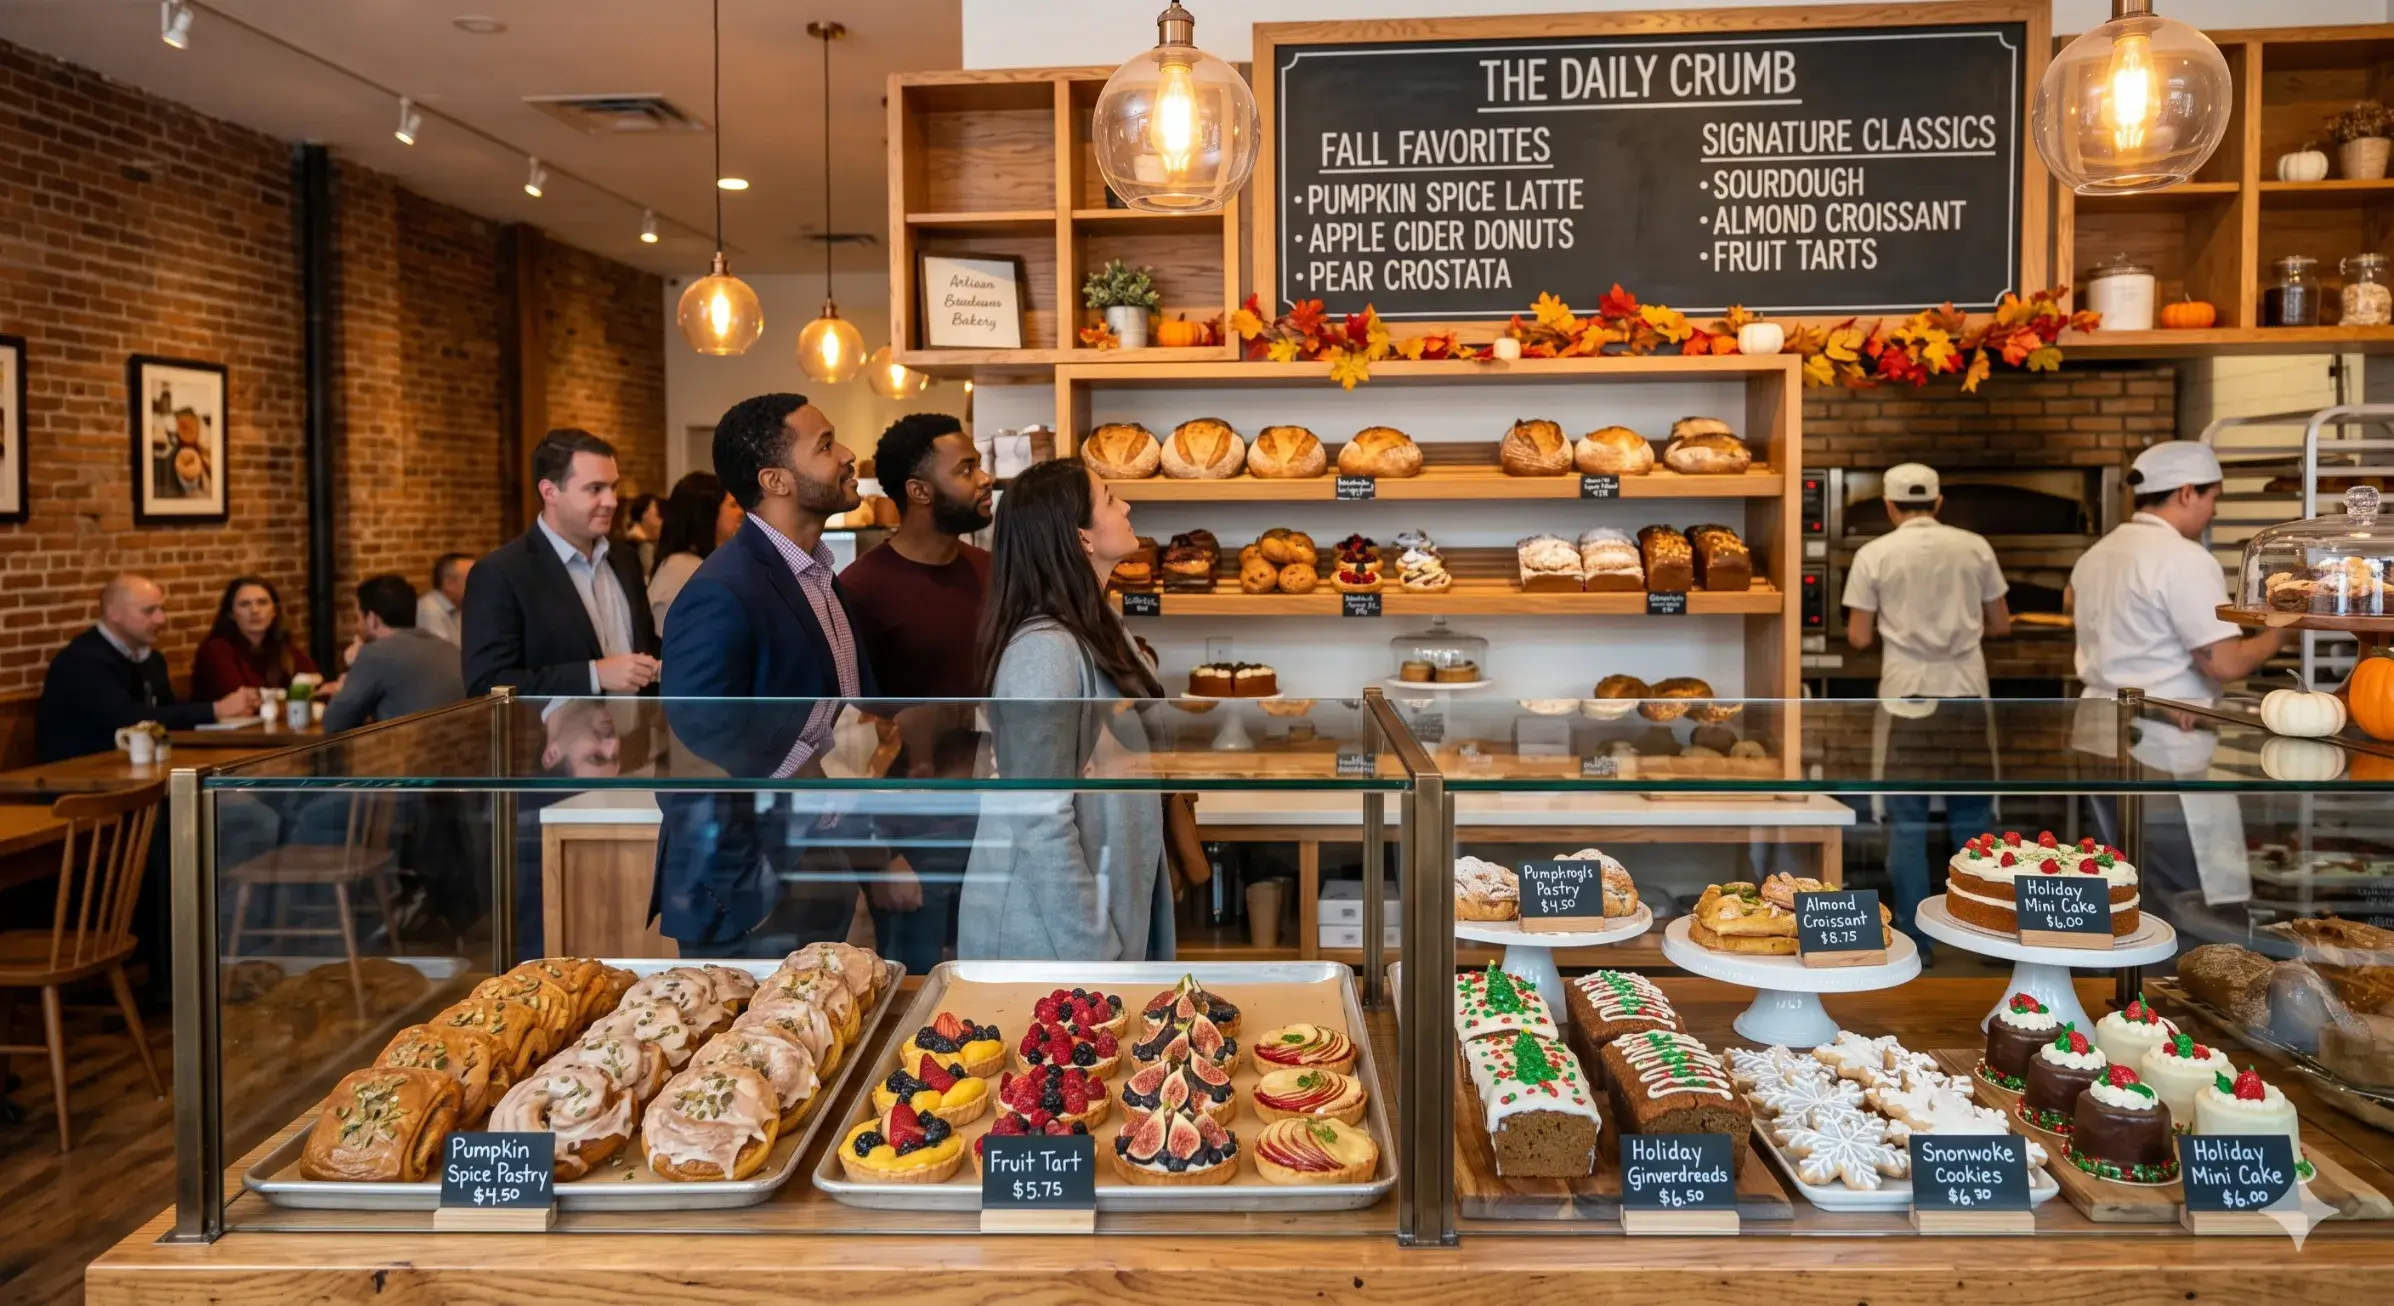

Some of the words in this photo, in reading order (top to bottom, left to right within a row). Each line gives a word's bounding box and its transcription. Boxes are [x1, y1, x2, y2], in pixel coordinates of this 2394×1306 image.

[1479, 58, 1548, 102] THE
[1560, 55, 1659, 100] DAILY
[1669, 50, 1797, 97] CRUMB
[1701, 119, 1854, 155] SIGNATURE
[1862, 115, 1997, 151] CLASSICS
[1321, 131, 1389, 167] FALL
[1398, 126, 1551, 165] FAVORITES
[1712, 166, 1865, 200] SOURDOUGH
[1308, 182, 1417, 215] PUMPKIN
[1425, 180, 1497, 213] SPICE
[1505, 178, 1585, 211] LATTE
[1712, 203, 1817, 235] ALMOND
[1824, 200, 1968, 233] CROISSANT
[1308, 221, 1386, 253] APPLE
[1394, 219, 1465, 252] CIDER
[1474, 217, 1575, 250] DONUTS
[1713, 239, 1787, 272] FRUIT
[1796, 237, 1878, 271] TARTS
[949, 274, 996, 289] Artisan
[1309, 260, 1375, 292] PEAR
[1383, 258, 1513, 290] CROSTATA
[951, 311, 997, 332] Bakery
[1536, 881, 1580, 899] Pastry
[2026, 879, 2083, 902] Holiday
[1540, 898, 1576, 914] $4.50
[1805, 893, 1856, 912] Almond
[2024, 898, 2055, 912] Mini
[2061, 898, 2098, 914] Cake
[1803, 910, 1868, 928] Croissant
[2046, 914, 2084, 929] $6.00
[452, 1137, 530, 1165] Pumpkin
[990, 1150, 1036, 1173] Fruit
[1040, 1150, 1082, 1172] Tart
[1632, 1139, 1702, 1168] Holiday
[1922, 1141, 2016, 1163] Snonwoke
[2193, 1139, 2264, 1168] Holiday
[447, 1164, 492, 1189] Spice
[497, 1161, 549, 1192] Pastry
[1935, 1164, 2003, 1184] Cookies
[2191, 1166, 2232, 1185] Mini
[2238, 1164, 2284, 1185] Cake
[473, 1185, 520, 1206] $4.50
[1012, 1179, 1063, 1200] $5.75
[1658, 1187, 1705, 1208] $6.50
[2222, 1188, 2269, 1208] $6.00
